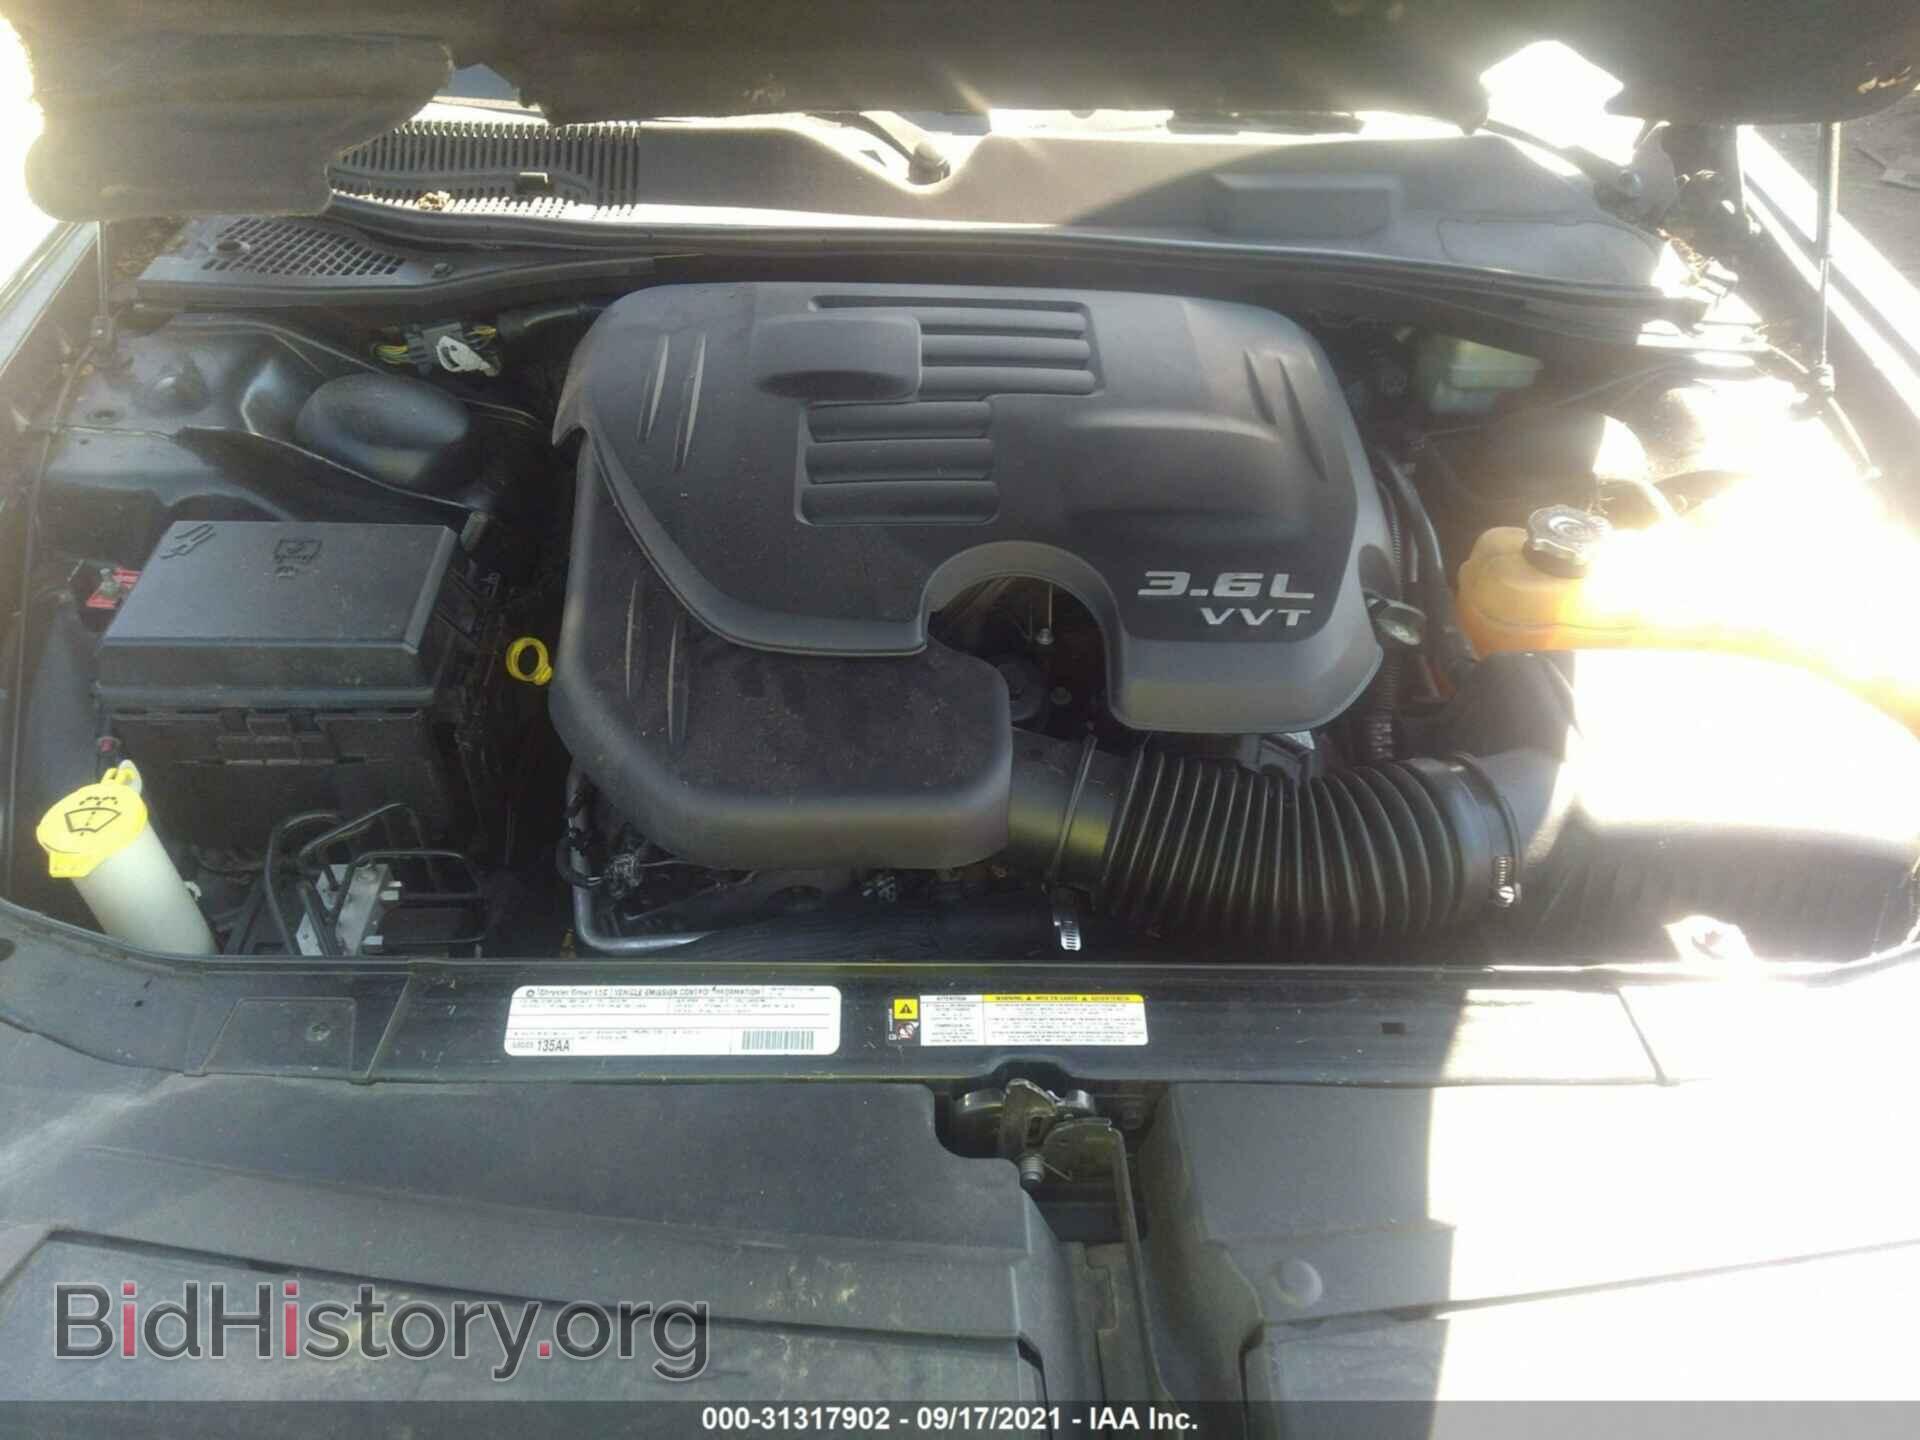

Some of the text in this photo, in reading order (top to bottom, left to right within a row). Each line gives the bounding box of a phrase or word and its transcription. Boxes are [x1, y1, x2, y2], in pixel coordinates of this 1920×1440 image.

[1137, 571, 1315, 599] 3.6L
[1200, 607, 1311, 626] VVT
[537, 1039, 570, 1052] 135AA
